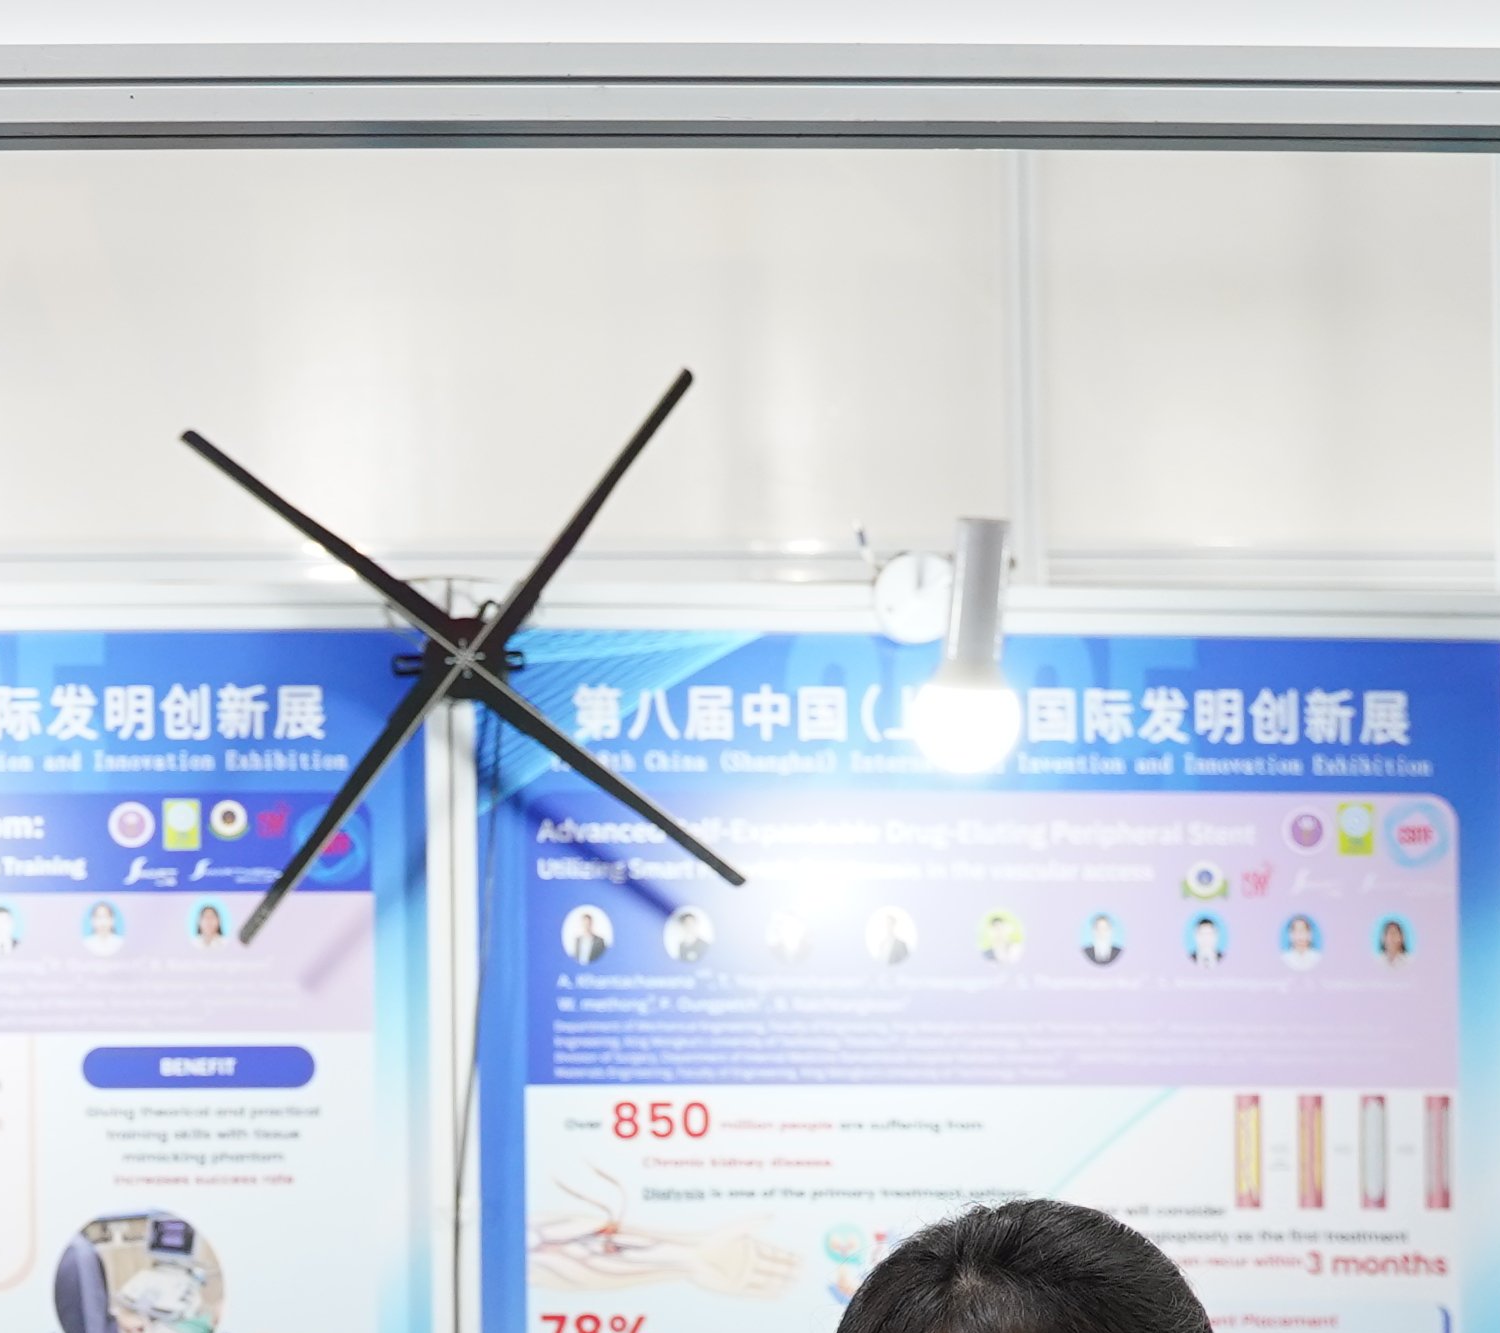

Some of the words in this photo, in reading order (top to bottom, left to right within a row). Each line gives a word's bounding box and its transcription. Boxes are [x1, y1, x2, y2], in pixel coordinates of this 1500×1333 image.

[44, 752, 81, 773] and
[612, 1100, 712, 1140] 850
[1305, 1251, 1324, 1275] 3
[1332, 1251, 1450, 1278] months
